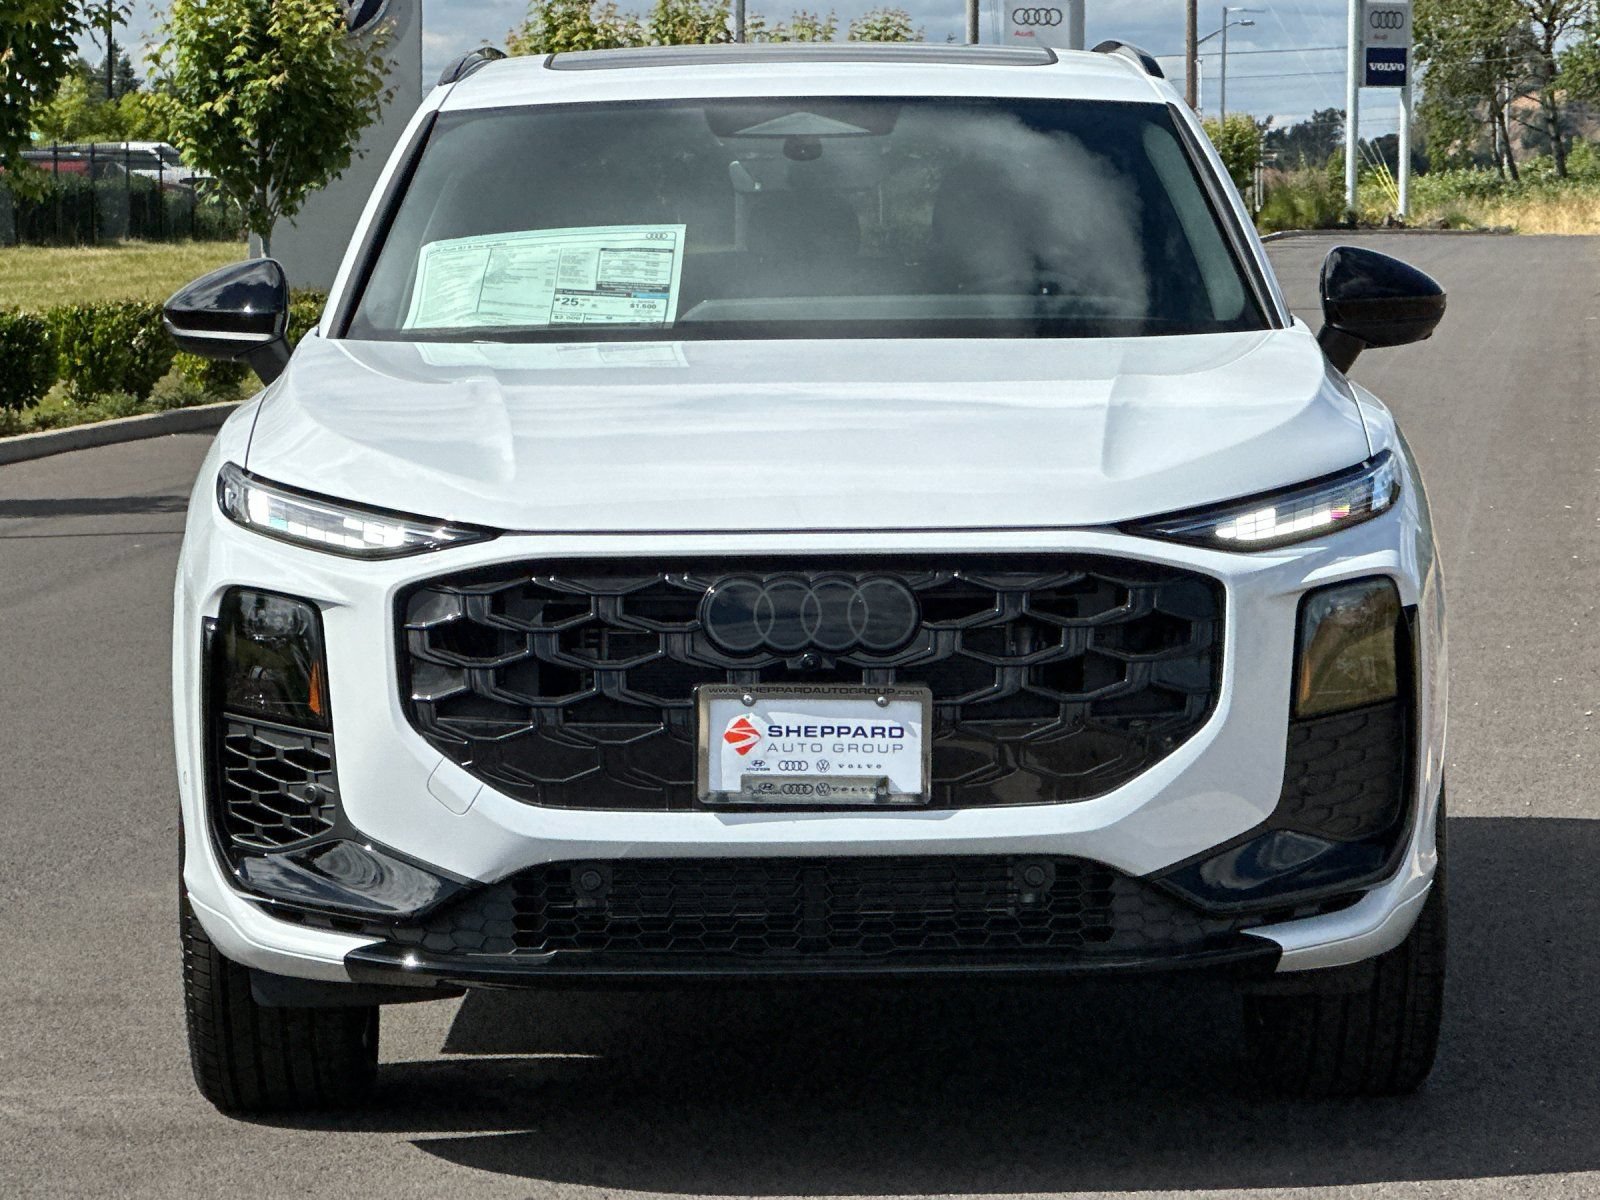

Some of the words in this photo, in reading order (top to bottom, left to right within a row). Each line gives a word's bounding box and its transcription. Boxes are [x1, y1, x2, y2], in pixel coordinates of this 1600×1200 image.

[1369, 62, 1405, 71] VOLVO
[561, 297, 579, 306] 25
[708, 686, 923, 695] www.SHEPPARDAUTOGROUP.com
[767, 725, 905, 739] SHEPPARD
[766, 742, 823, 753] AUTO
[832, 743, 904, 754] GROUP
